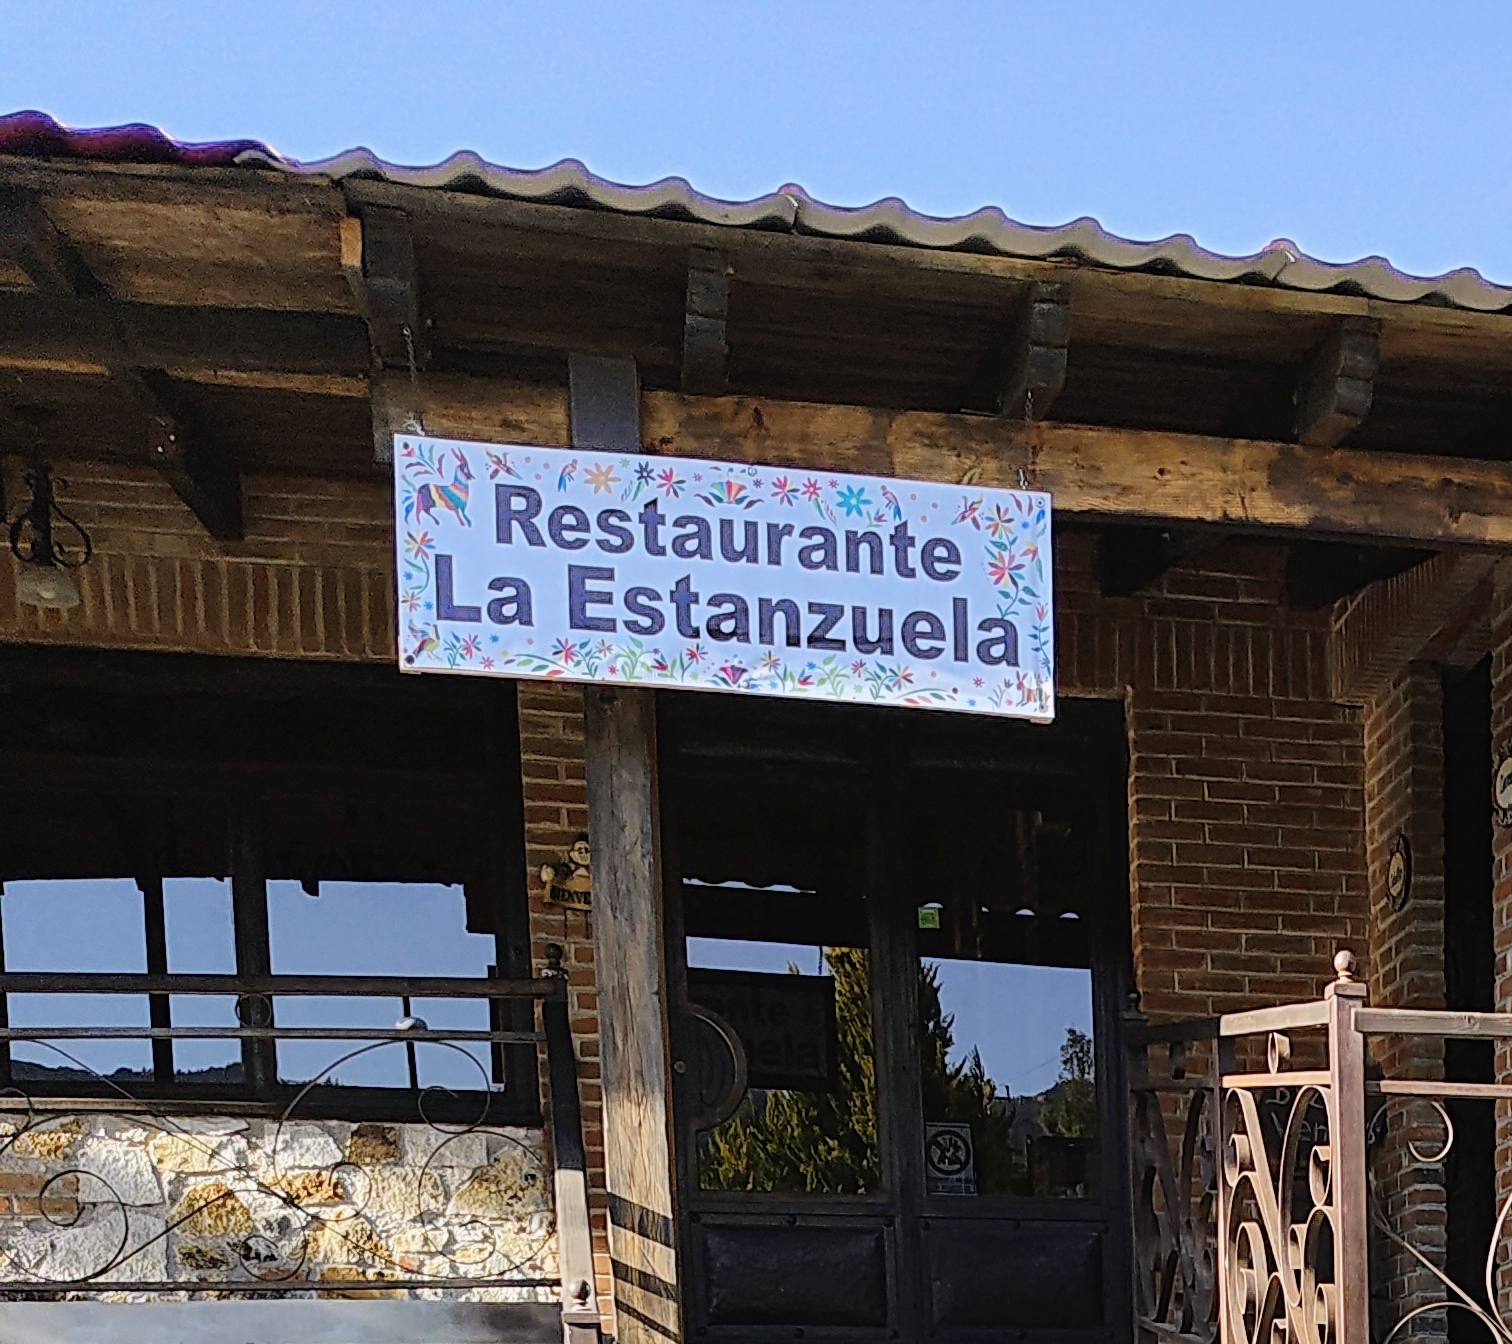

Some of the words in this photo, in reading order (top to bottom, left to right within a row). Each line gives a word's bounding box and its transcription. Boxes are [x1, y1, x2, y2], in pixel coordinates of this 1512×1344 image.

[494, 483, 962, 582] Restaurante
[434, 553, 534, 627] La
[567, 563, 1021, 668] Estanzuela
